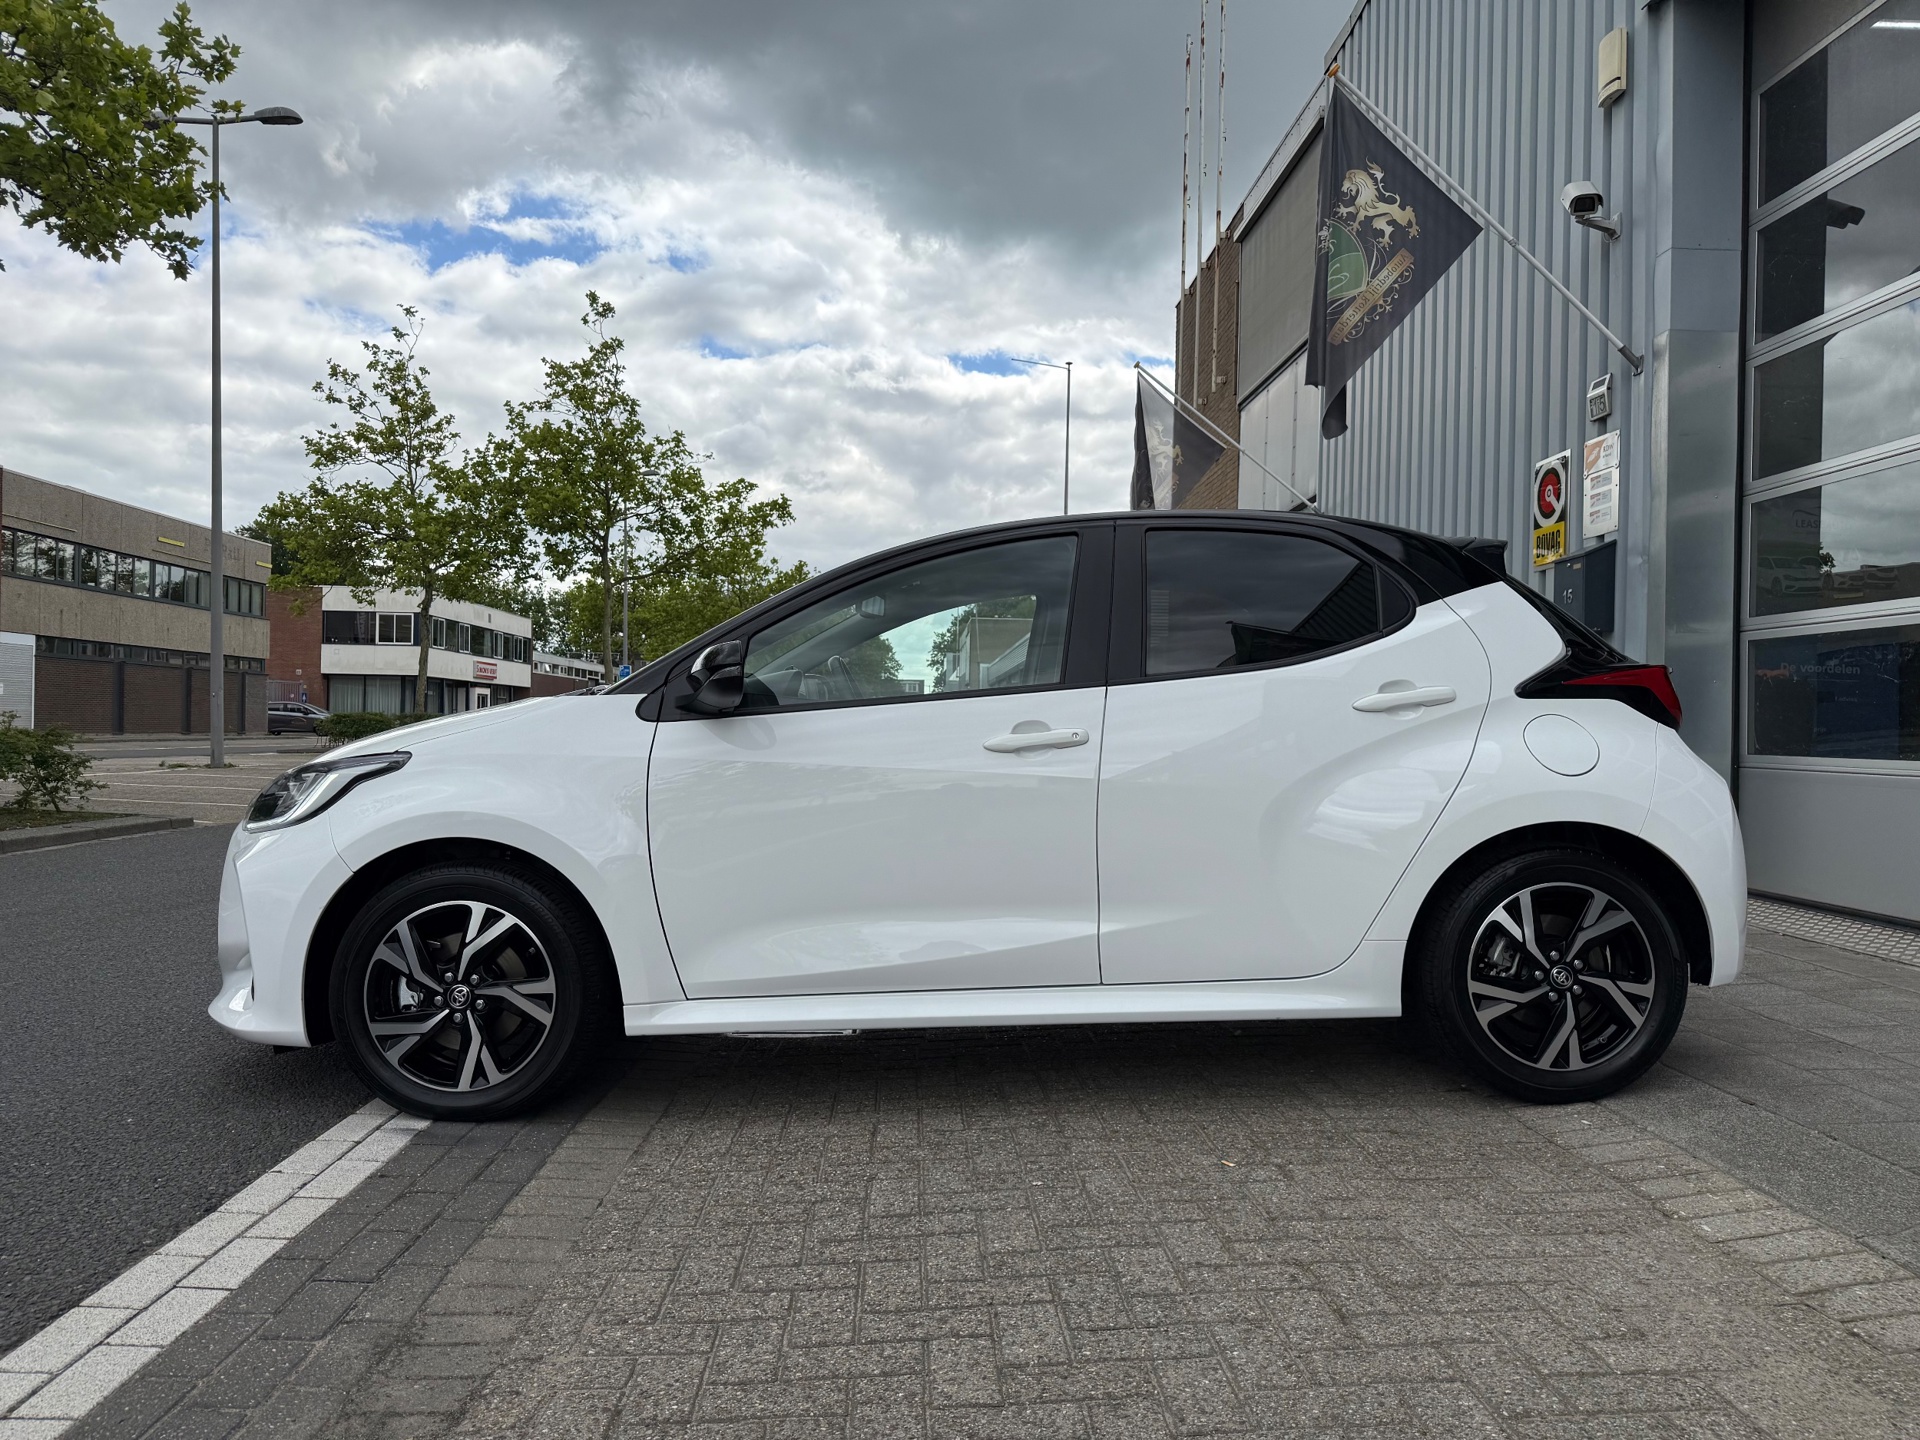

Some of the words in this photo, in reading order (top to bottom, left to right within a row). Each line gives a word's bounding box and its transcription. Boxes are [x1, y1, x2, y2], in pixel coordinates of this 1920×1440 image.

[1536, 529, 1561, 559] BOVAG
[1562, 588, 1573, 604] 15
[1780, 662, 1796, 673] De
[1800, 664, 1861, 674] voordelen
